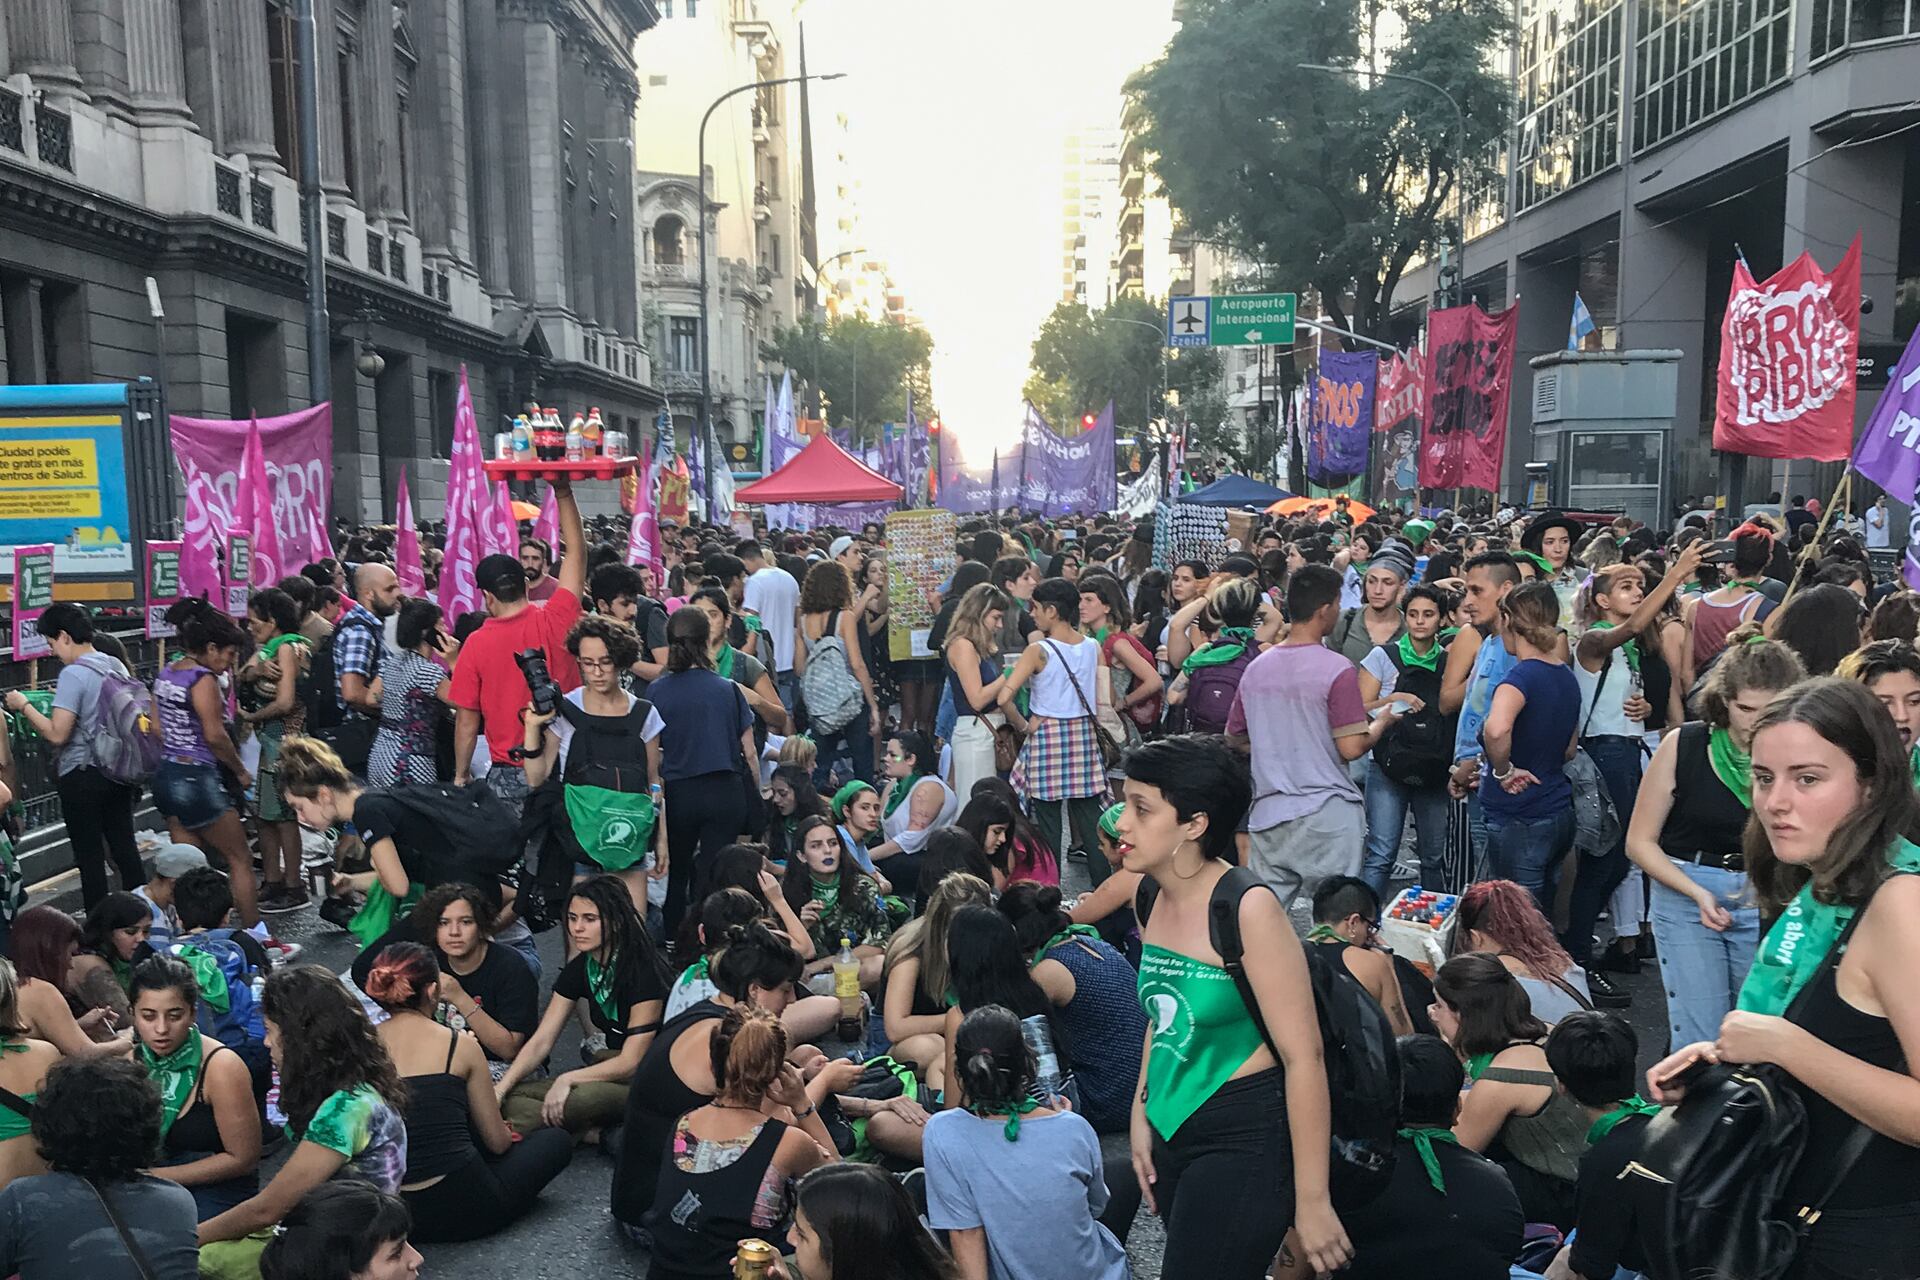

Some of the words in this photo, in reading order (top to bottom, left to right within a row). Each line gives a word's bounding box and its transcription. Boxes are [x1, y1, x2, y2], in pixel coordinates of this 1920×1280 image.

[1221, 298, 1286, 310] Aeropuerto
[1216, 312, 1290, 325] Internacional
[1171, 336, 1207, 346] Ezeiza
[1889, 409, 1920, 453] PT
[0, 447, 34, 457] Ciudad
[37, 446, 71, 457] podés
[12, 460, 42, 470] gratis
[45, 460, 58, 468] en
[62, 458, 84, 467] más
[37, 470, 50, 479] de
[53, 470, 87, 479] Salud.
[1159, 966, 1185, 976] Seguro
[1186, 971, 1192, 979] y
